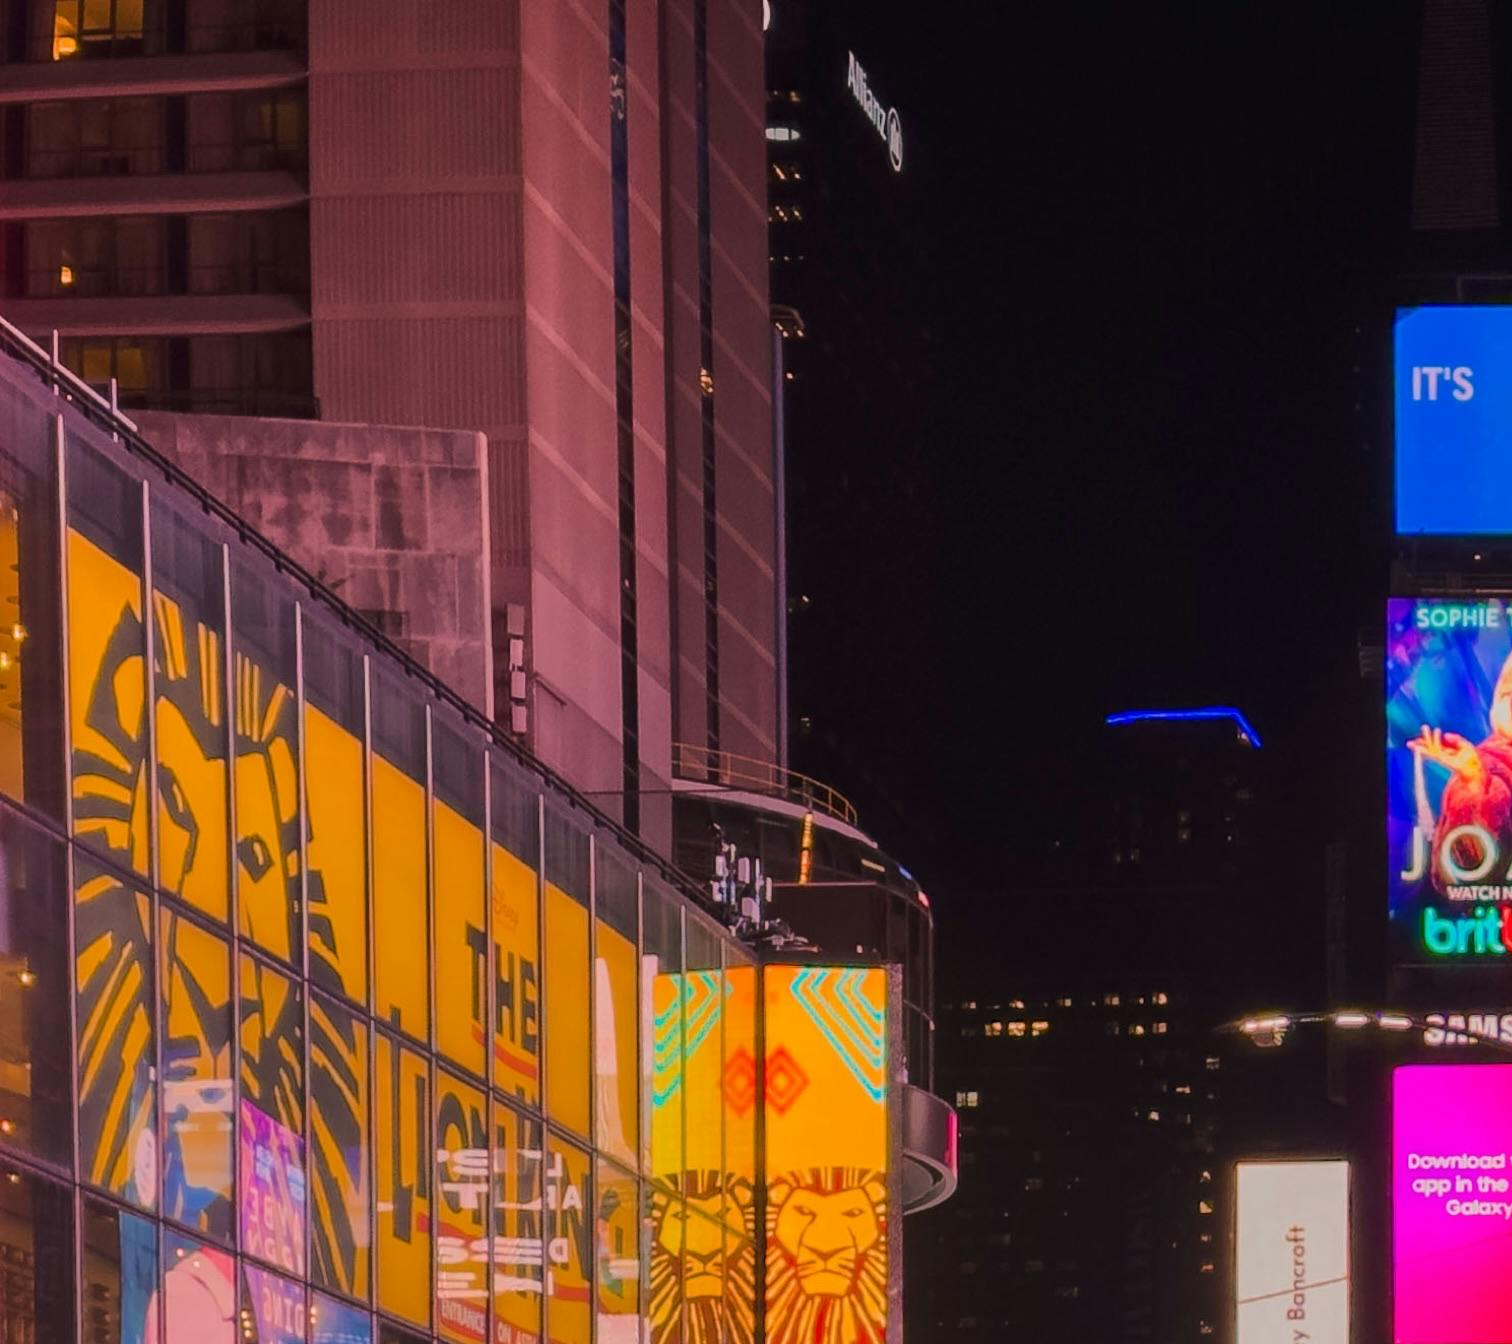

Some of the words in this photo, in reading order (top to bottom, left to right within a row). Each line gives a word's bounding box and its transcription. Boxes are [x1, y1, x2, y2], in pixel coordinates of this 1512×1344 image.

[1411, 366, 1474, 401] IT'S
[1416, 607, 1499, 628] SOPHIE
[1447, 886, 1500, 900] WATCH
[466, 920, 538, 1055] THE
[1408, 1153, 1504, 1169] Download
[1412, 1179, 1451, 1197] app
[1455, 1175, 1472, 1192] in
[1477, 1176, 1509, 1192] the
[1285, 1225, 1306, 1321] Bancroft
